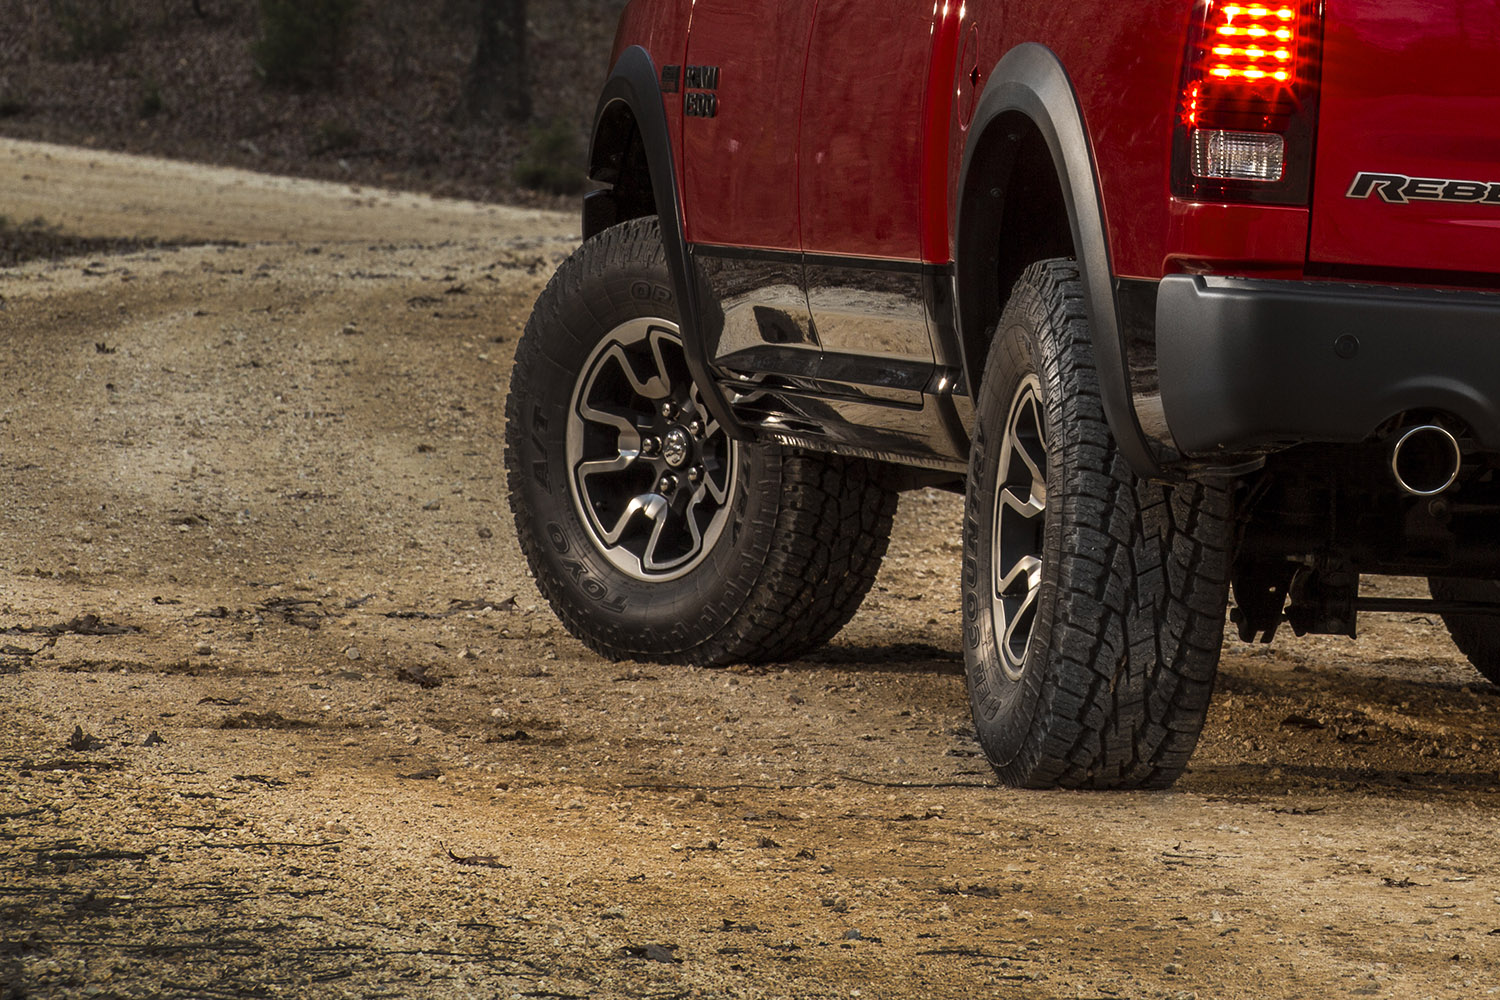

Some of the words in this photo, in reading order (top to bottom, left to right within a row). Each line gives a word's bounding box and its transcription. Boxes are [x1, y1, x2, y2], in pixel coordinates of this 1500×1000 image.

[531, 403, 552, 495] A/T
[545, 521, 628, 614] TOYO
[966, 421, 986, 649] COUNTRY
